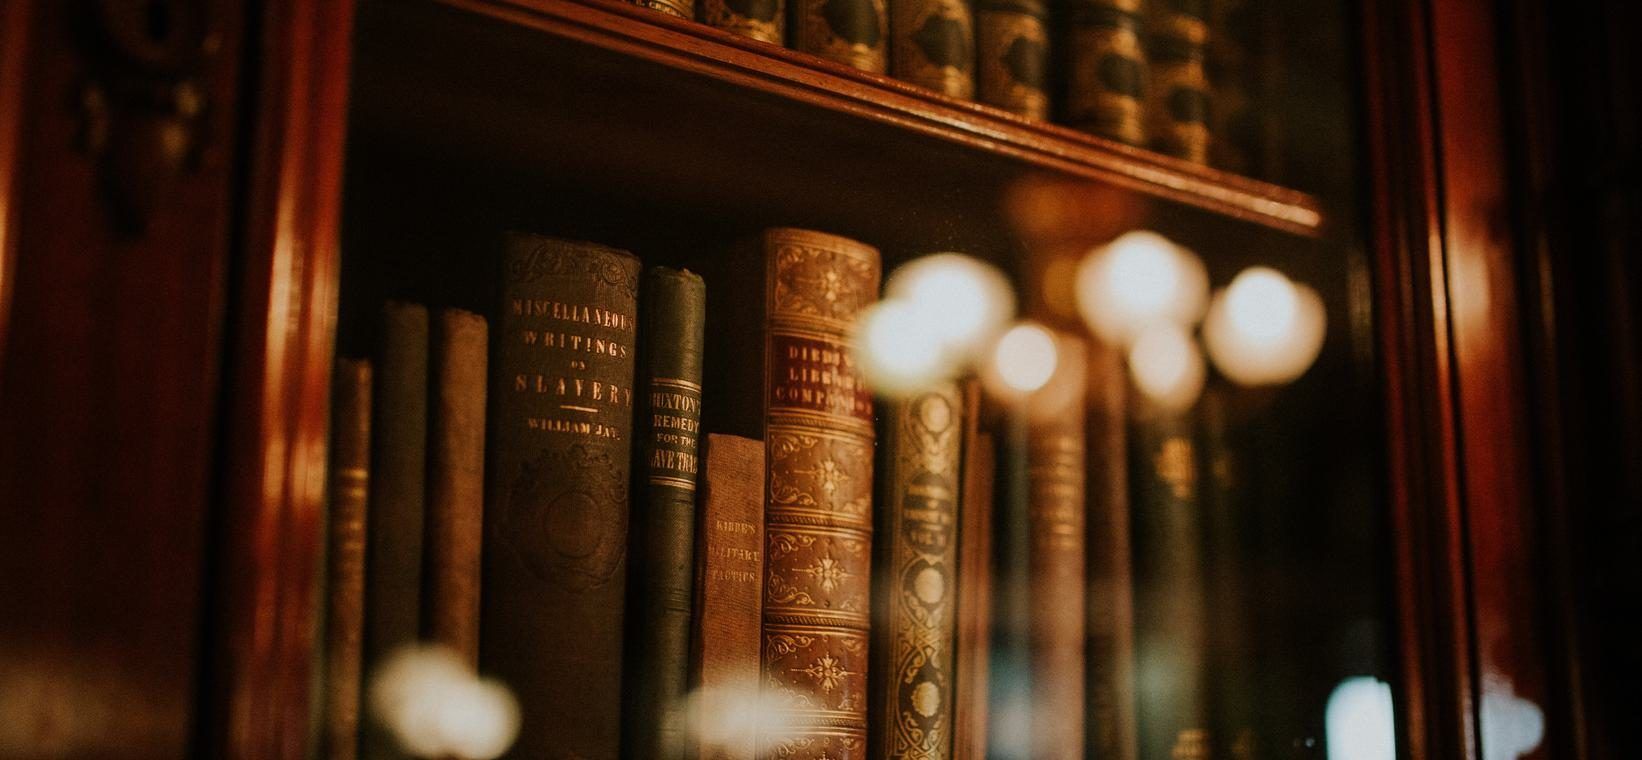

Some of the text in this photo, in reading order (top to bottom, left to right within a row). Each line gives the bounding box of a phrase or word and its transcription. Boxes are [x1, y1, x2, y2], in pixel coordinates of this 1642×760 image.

[513, 299, 633, 332] MISCELLANEOUS
[525, 331, 627, 358] WRITINGS
[514, 375, 632, 407] SLAVERY
[528, 418, 590, 434] WILLIAM
[654, 414, 699, 434] REMEDY
[657, 433, 696, 448] FOR THE
